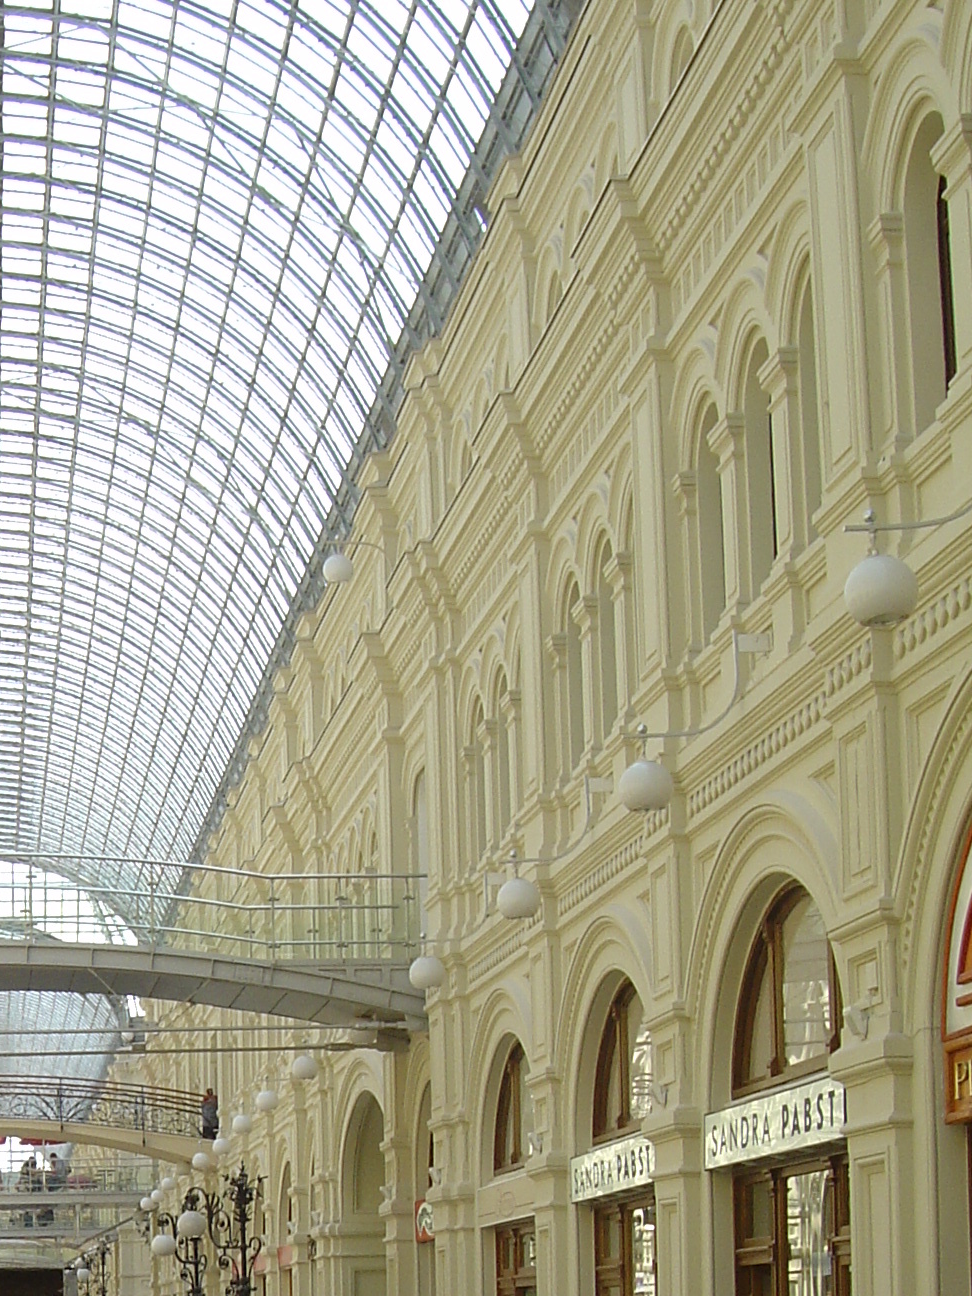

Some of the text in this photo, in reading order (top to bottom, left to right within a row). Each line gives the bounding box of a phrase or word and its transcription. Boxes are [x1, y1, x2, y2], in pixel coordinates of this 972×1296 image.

[711, 1089, 835, 1157] SANDRA PABST
[574, 1144, 650, 1195] SANDRA PABST
